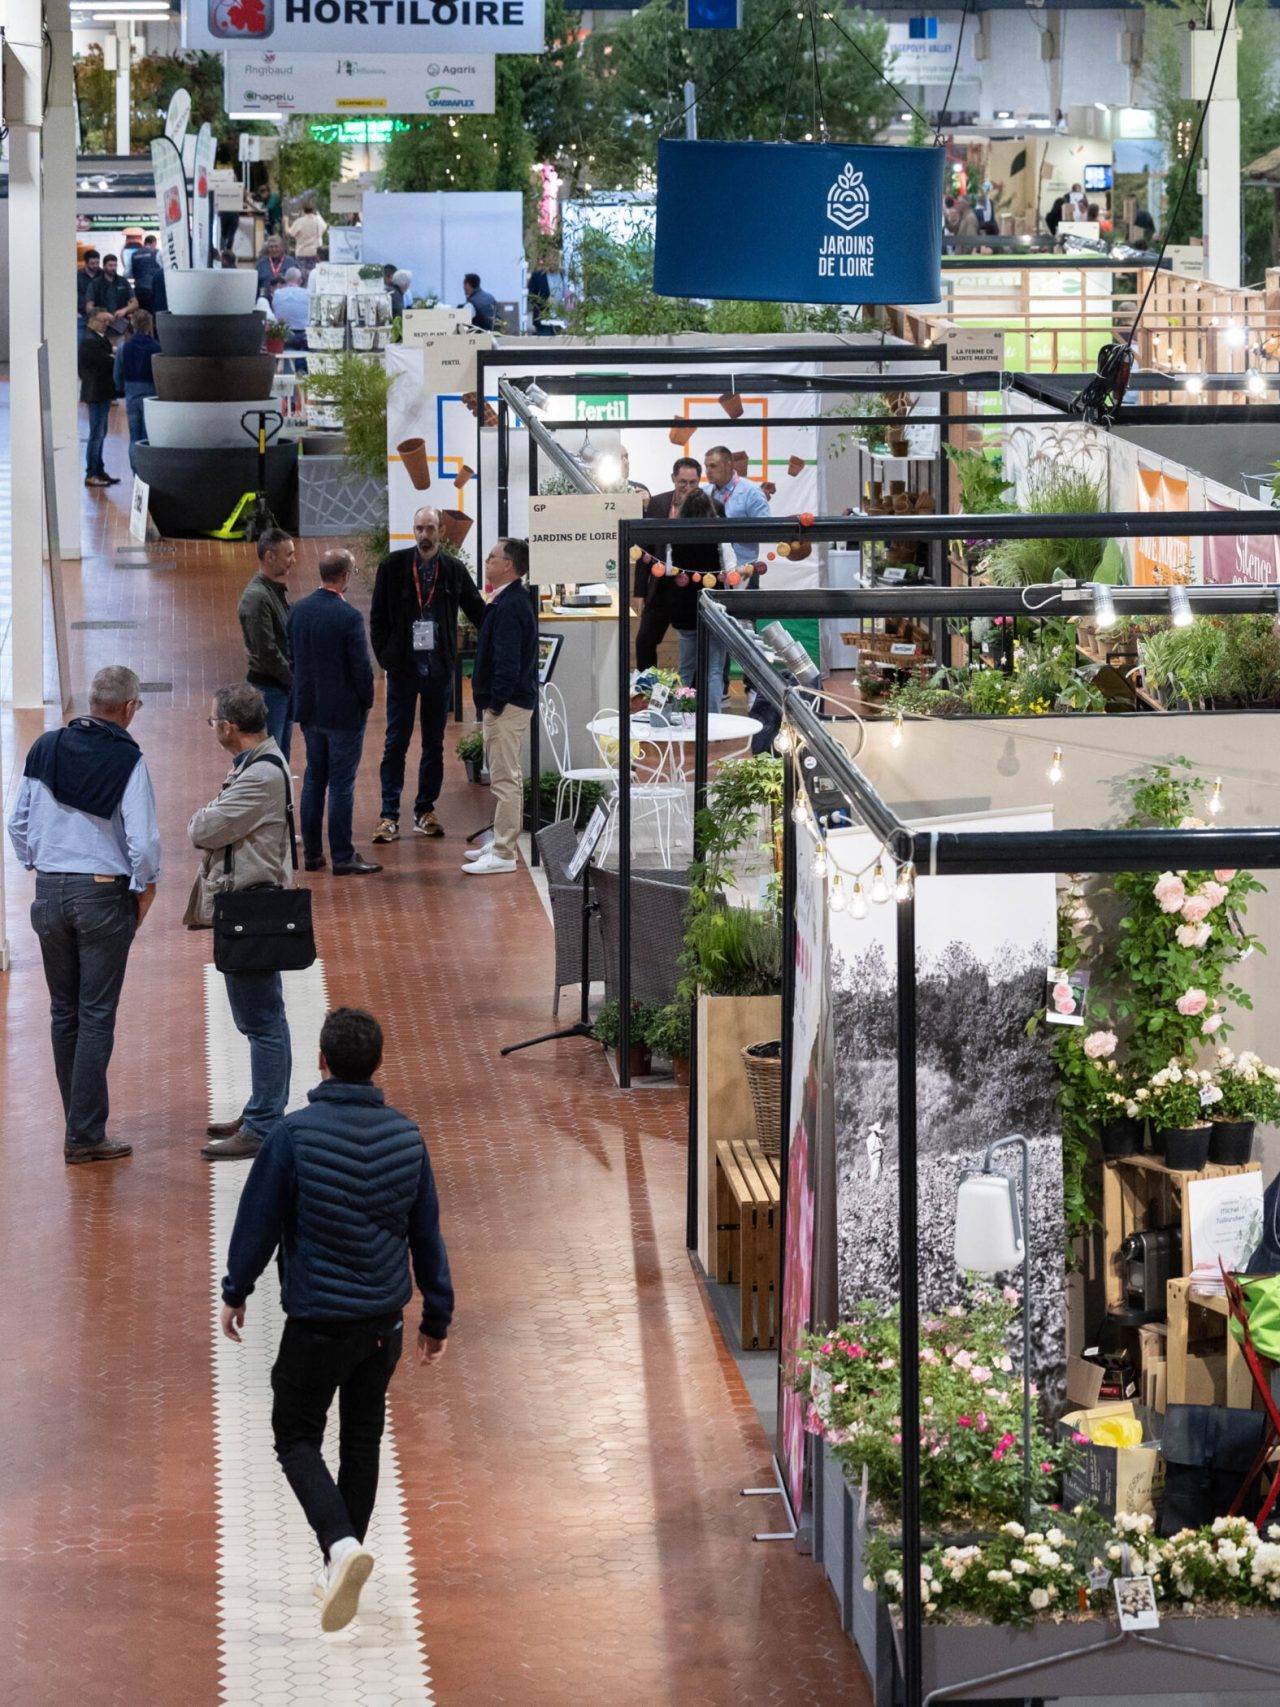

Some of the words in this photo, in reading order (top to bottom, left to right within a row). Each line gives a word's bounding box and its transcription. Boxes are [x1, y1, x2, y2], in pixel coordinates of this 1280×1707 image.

[285, 0, 525, 26] HORTILOIRE
[442, 65, 476, 76] Agaris
[818, 235, 874, 255] JARDINS
[818, 257, 835, 277] DE
[839, 257, 874, 277] LOIRE
[577, 402, 626, 420] fertil
[533, 504, 546, 512] GP
[604, 502, 616, 510] 72
[532, 533, 573, 542] JARDINS
[574, 533, 587, 541] DE
[589, 532, 617, 541] LOIRE
